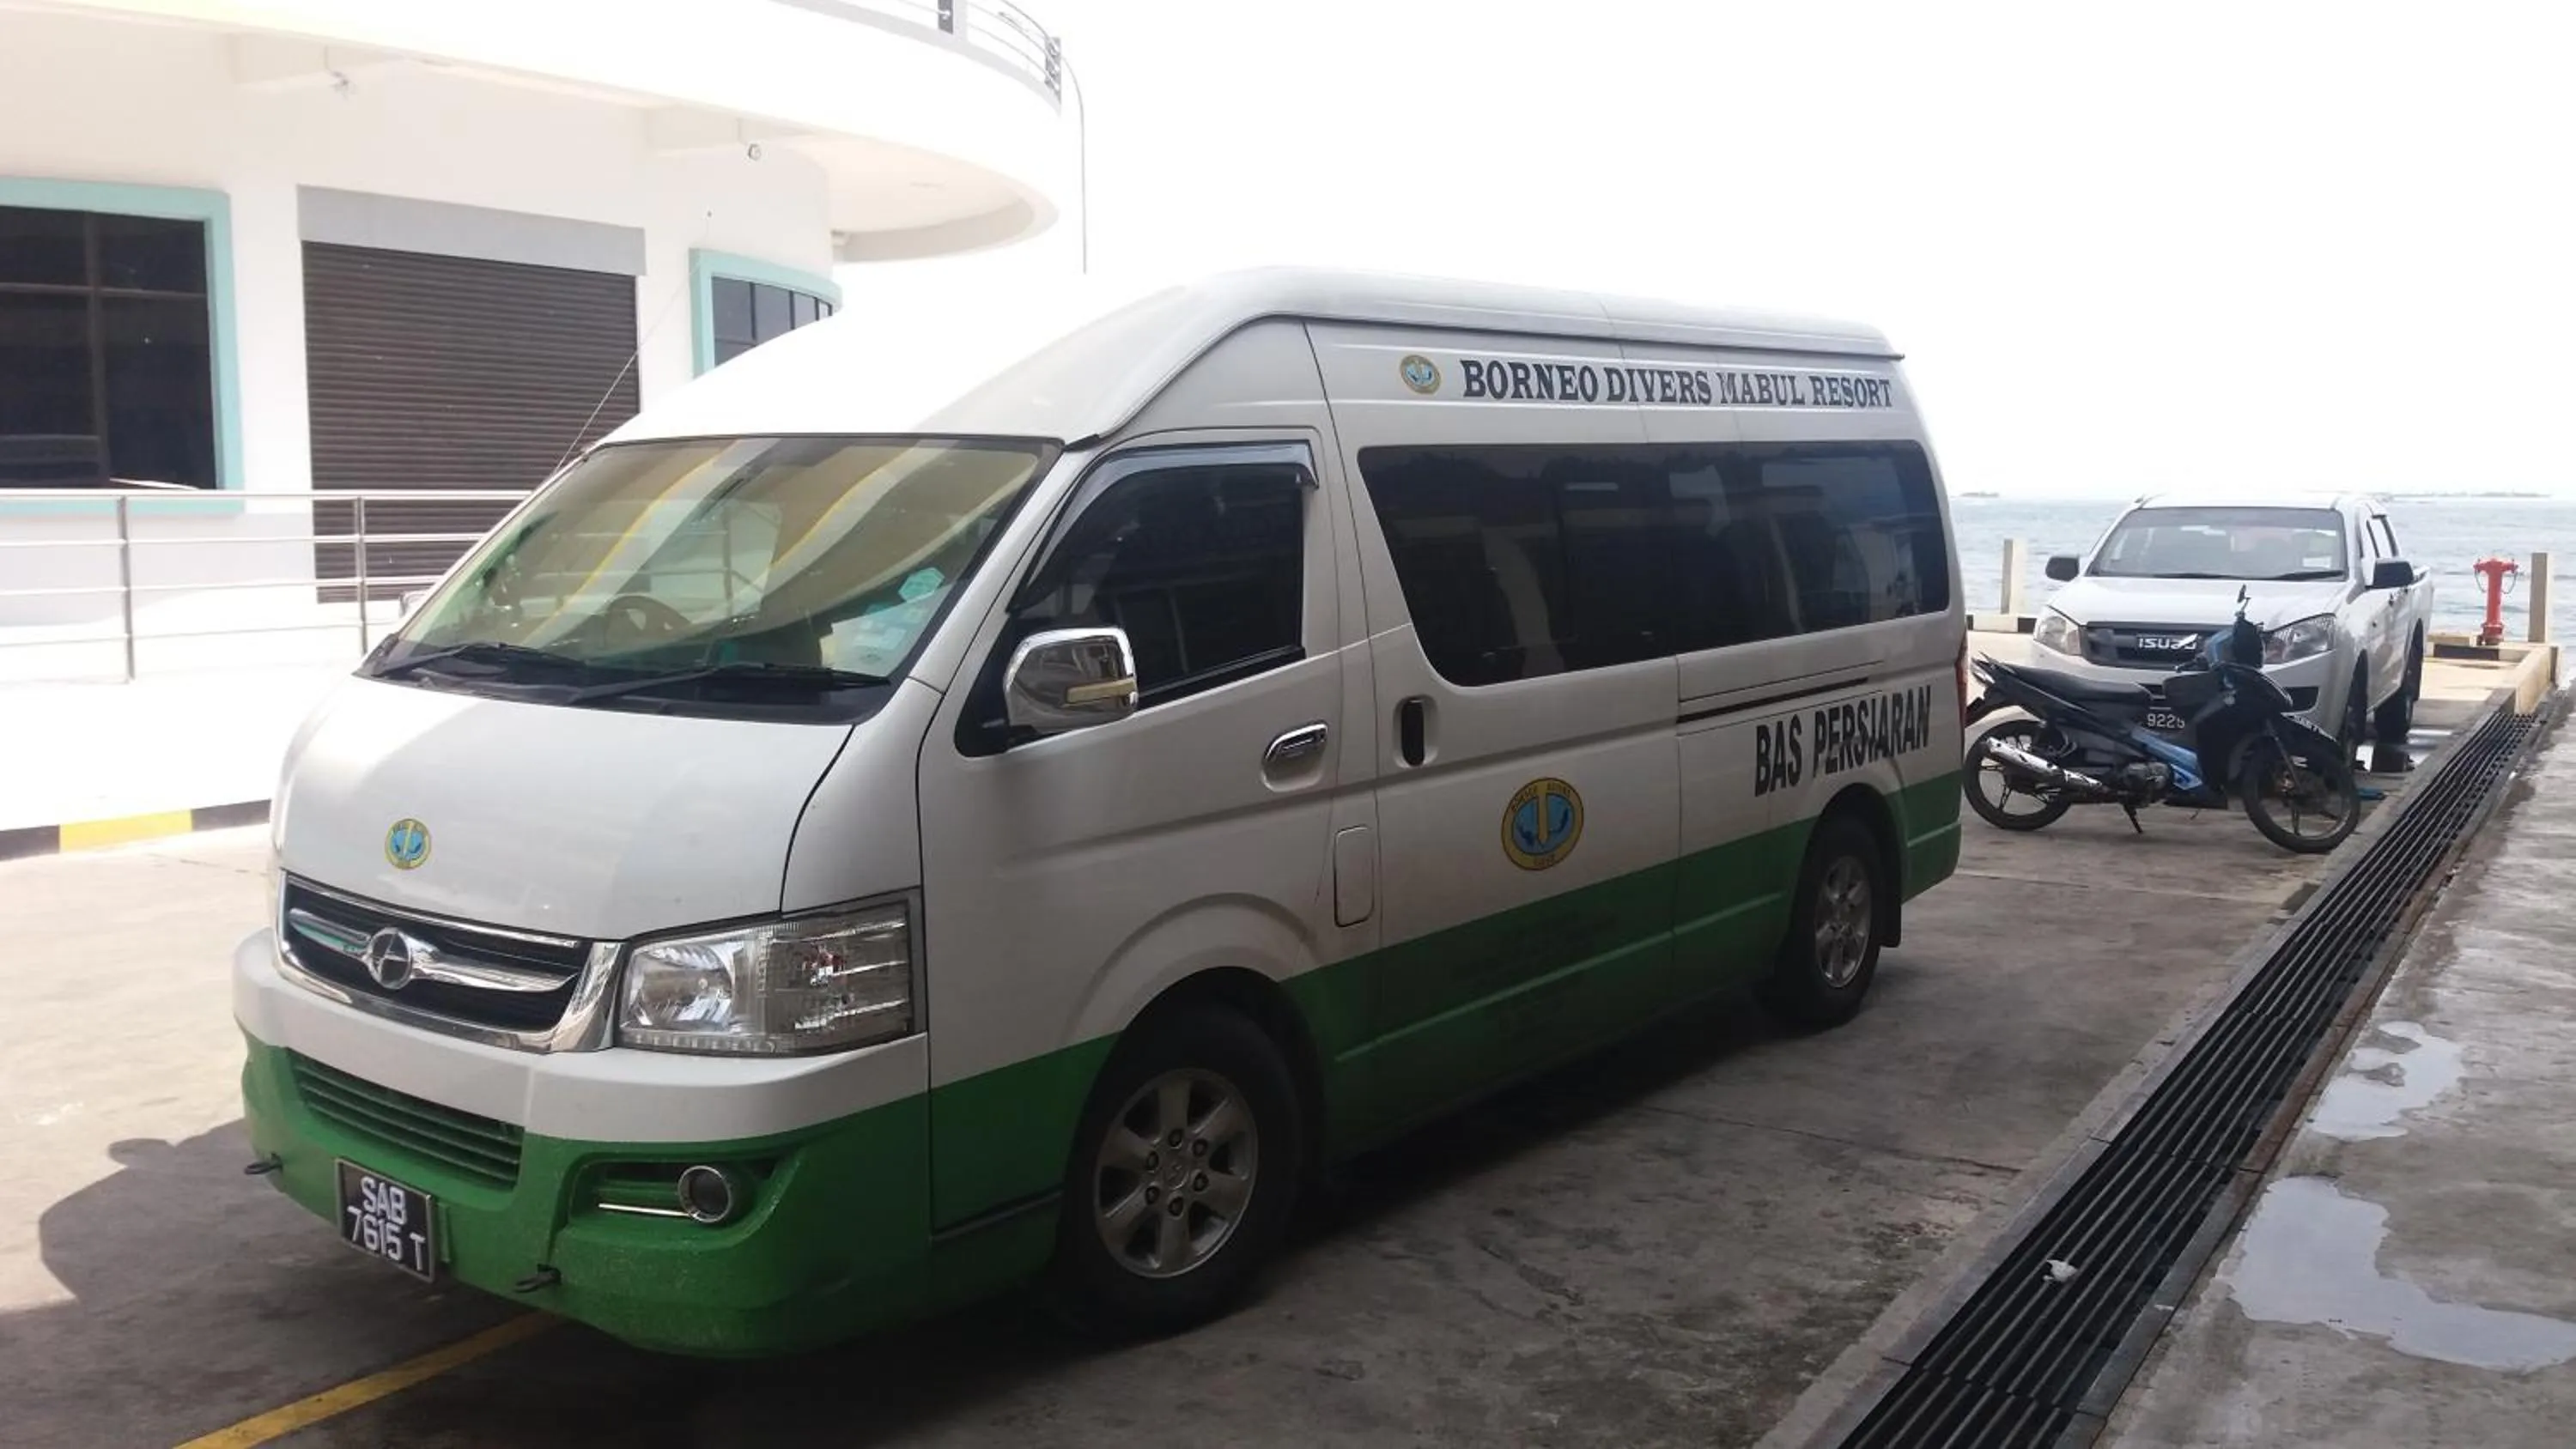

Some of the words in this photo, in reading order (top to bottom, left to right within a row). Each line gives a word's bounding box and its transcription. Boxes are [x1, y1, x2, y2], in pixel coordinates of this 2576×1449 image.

[1460, 360, 1598, 403] BORNEO
[1603, 367, 1712, 405] DIVERS
[1716, 372, 1806, 405] MABUL
[1807, 375, 1892, 408] RESORT
[1755, 713, 1802, 797] BAS
[1813, 685, 1931, 778] PERSIARAN
[361, 1175, 407, 1226] SAB
[347, 1205, 403, 1261] 7615
[409, 1232, 426, 1271] T
